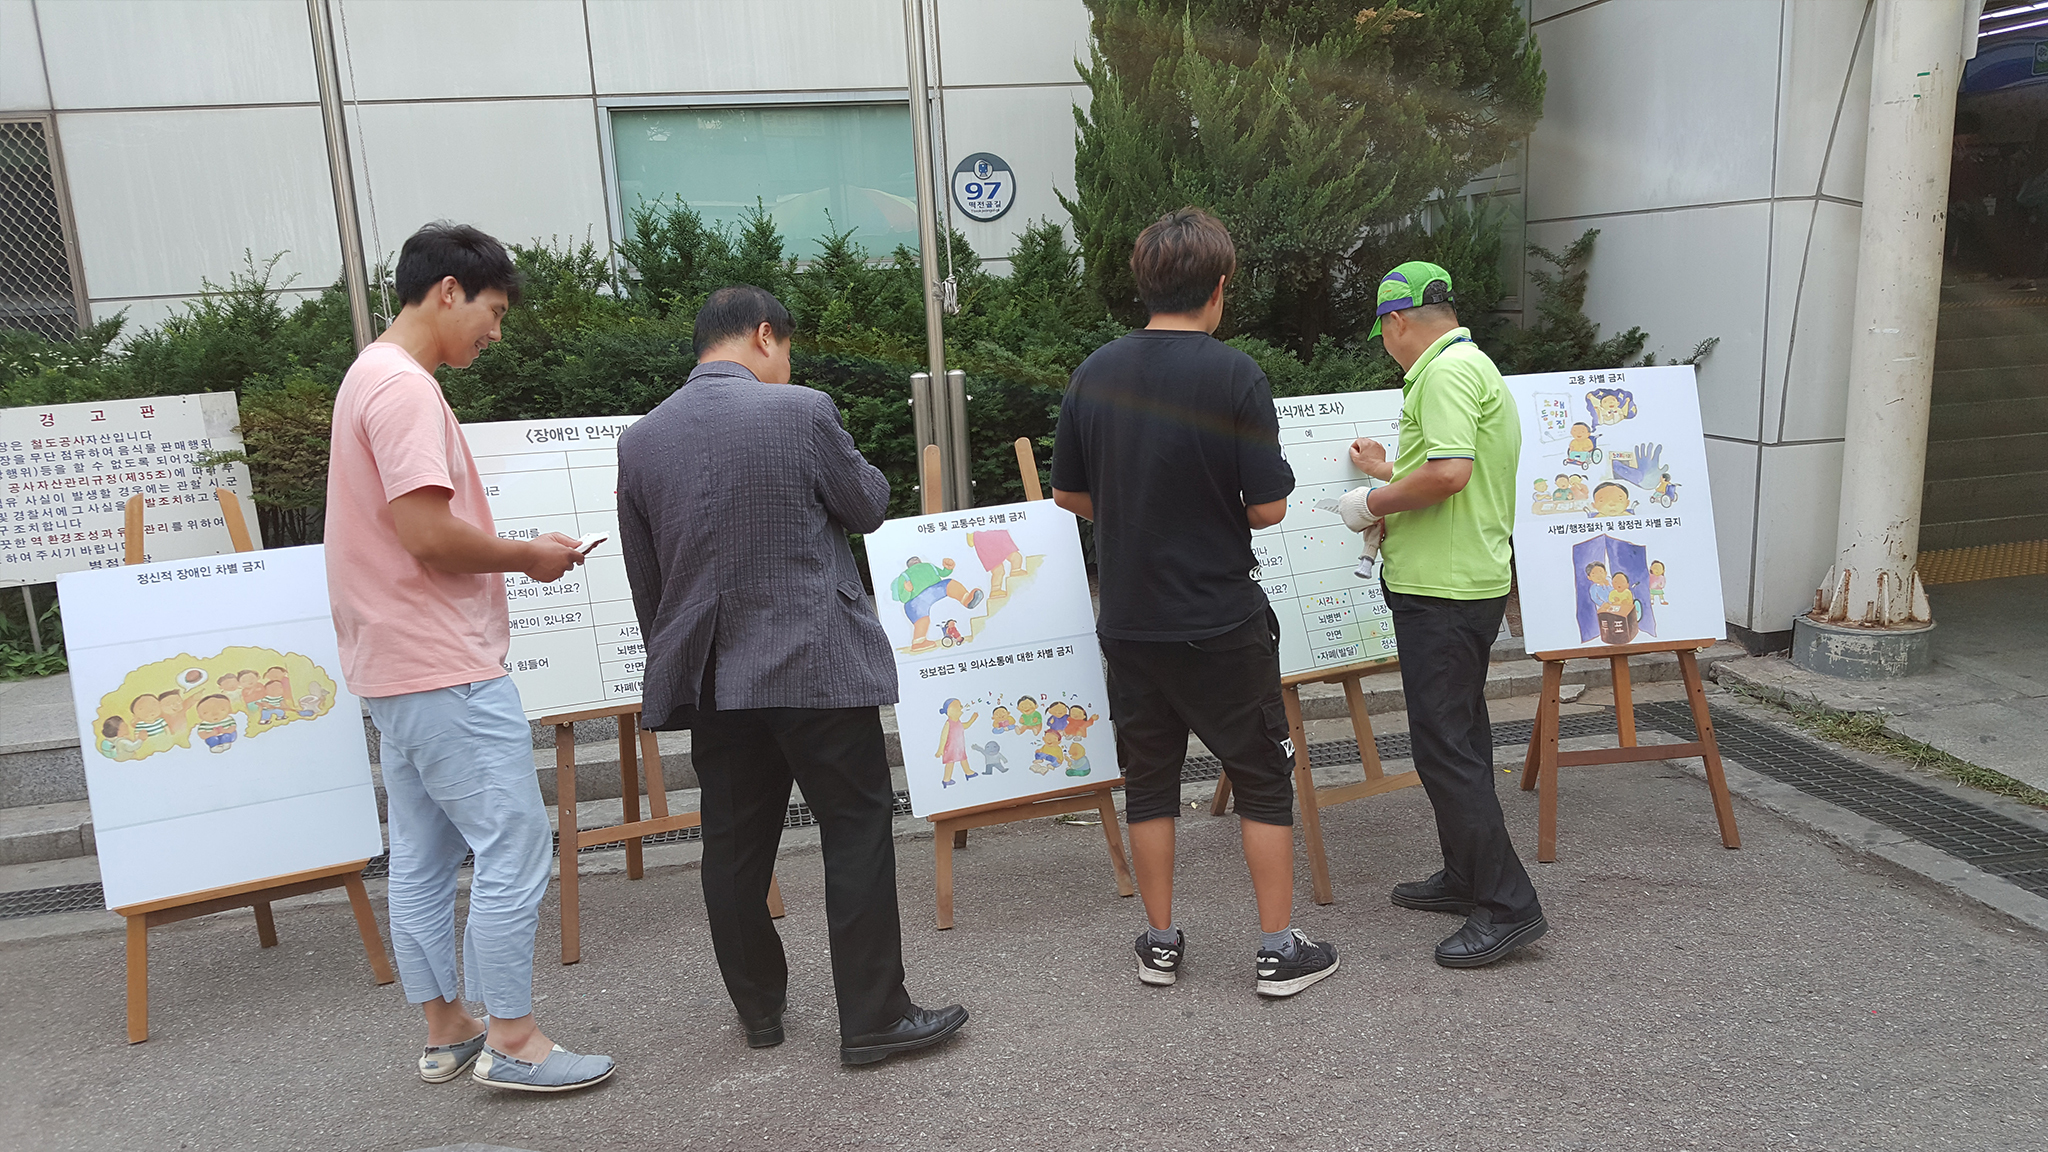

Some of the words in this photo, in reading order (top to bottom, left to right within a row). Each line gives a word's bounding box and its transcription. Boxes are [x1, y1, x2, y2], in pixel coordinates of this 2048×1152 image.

[965, 182, 1001, 200] 97
[1568, 375, 1586, 385] 고용
[1589, 374, 1605, 384] 차별
[1608, 373, 1625, 383] 금지
[40, 413, 55, 427] 경
[90, 410, 106, 422] 고
[140, 405, 155, 418] 판
[1304, 429, 1314, 438] 예
[30, 451, 56, 463] 무단
[60, 446, 114, 461] 점유하여
[118, 442, 156, 456] 음식물
[161, 438, 212, 453] 판매행위
[0, 464, 66, 479] 행위)등을
[73, 462, 85, 473] 할
[92, 461, 104, 471] 수
[110, 456, 149, 470] 없도록
[0, 497, 18, 509] 유
[25, 493, 65, 506] 사실이
[72, 487, 111, 502] 발생할
[118, 483, 170, 498] 경우에는
[176, 479, 202, 492] 관할
[13, 518, 82, 534] 조치합니다
[938, 521, 948, 531] 및
[951, 516, 986, 530] 교통수단
[989, 514, 1006, 524] 차별
[1009, 511, 1027, 522] 금지
[1547, 524, 1604, 534] 사법/행정절차
[1605, 522, 1614, 531] 및
[1617, 520, 1643, 530] 참정권
[1645, 518, 1662, 528] 차별
[1664, 517, 1682, 526] 금지
[30, 536, 43, 547] 역
[47, 529, 113, 545] 환경조성과
[187, 517, 225, 531] 위하여
[36, 548, 76, 560] 주시기
[137, 571, 173, 585] 정신적
[176, 566, 211, 580] 장애인
[215, 563, 238, 575] 차별
[242, 560, 266, 573] 금지
[542, 582, 580, 596] 있나요?
[1263, 583, 1288, 595] 나요?
[1372, 604, 1388, 615] 신장
[543, 611, 582, 626] 있나요?
[619, 626, 639, 637] 시각
[1326, 629, 1343, 641] 안면
[1380, 621, 1388, 631] 간
[517, 658, 549, 672] 힘들어
[624, 661, 645, 673] 안면
[919, 664, 955, 679] 정보접근
[958, 662, 967, 672] 및
[970, 655, 1014, 670] 의사소통에
[1016, 651, 1034, 662] 대한
[1037, 648, 1054, 659] 차별
[1057, 645, 1074, 657] 금지
